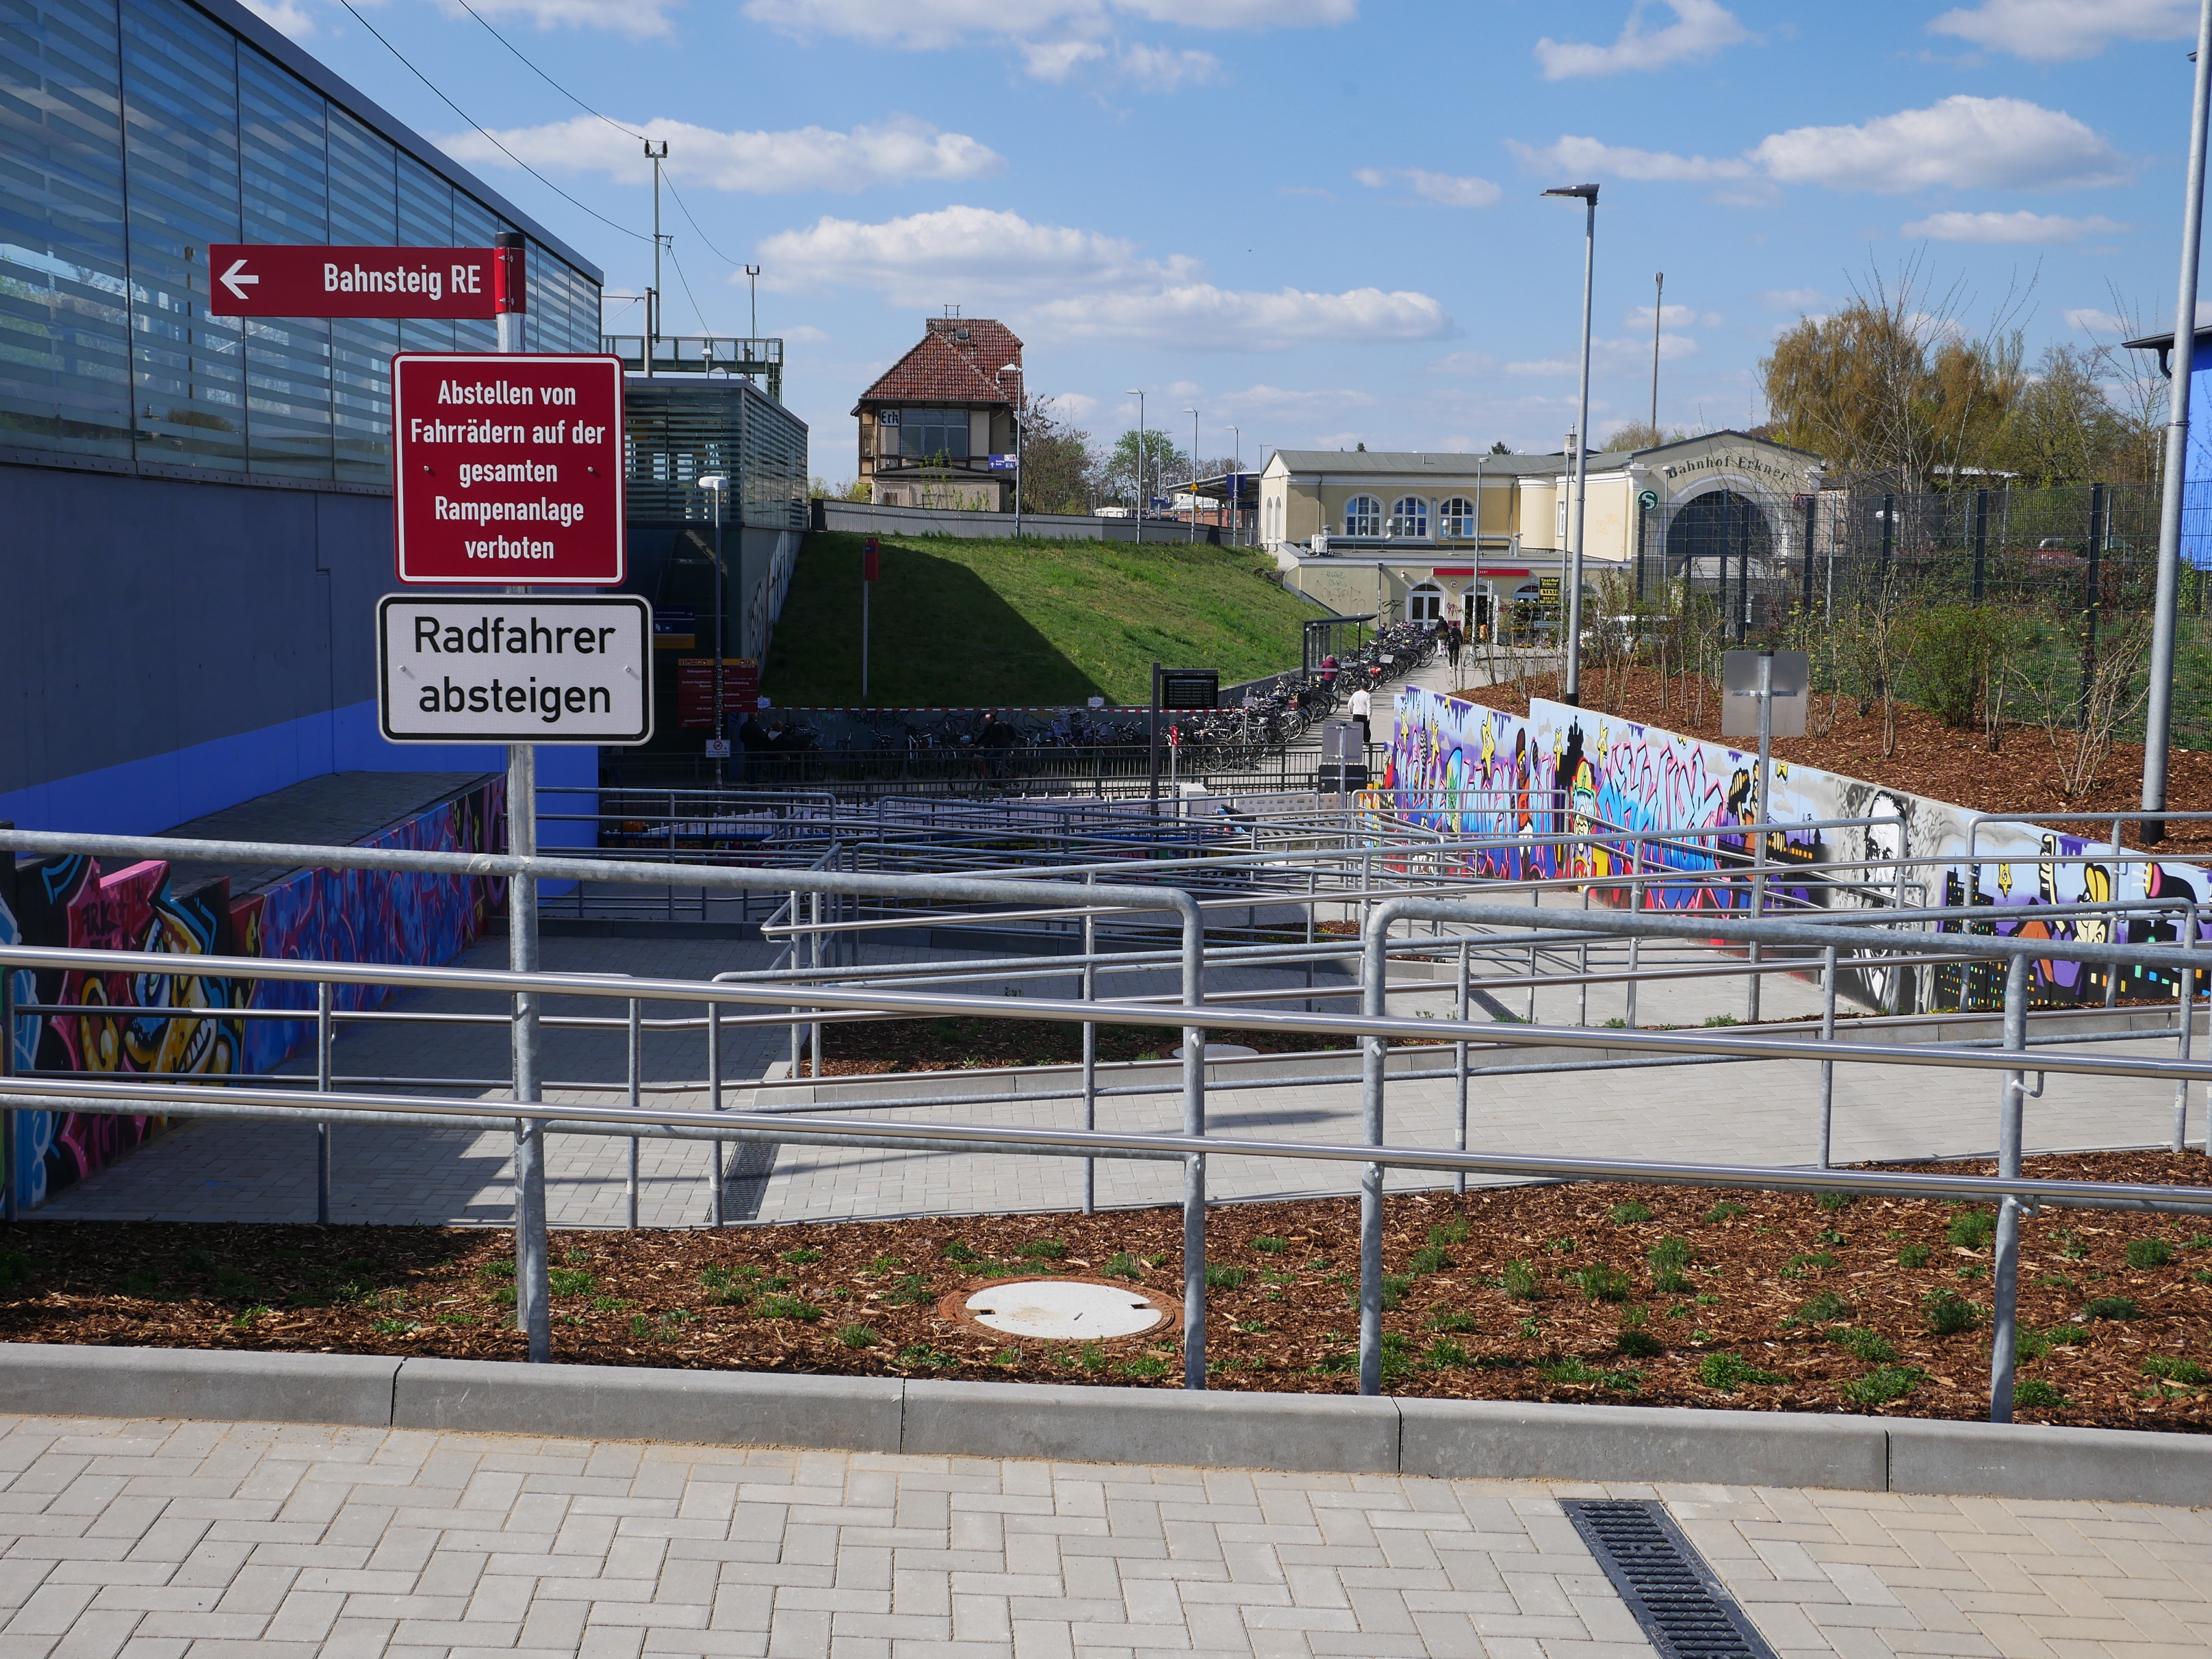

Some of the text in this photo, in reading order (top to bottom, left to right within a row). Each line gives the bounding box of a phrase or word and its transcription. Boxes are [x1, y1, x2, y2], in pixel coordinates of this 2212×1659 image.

[324, 263, 481, 300] Bahnsteig RE
[438, 381, 575, 405] Abstellen von
[882, 411, 899, 424] Erk
[411, 418, 605, 444] Fahrrädern auf der
[460, 460, 557, 487] gesamten
[1667, 455, 1789, 480] Bahnhof Erkner
[435, 496, 584, 527] Rampenanlage
[465, 535, 554, 559] verboten
[415, 617, 616, 654] Radfahrer
[420, 676, 610, 723] absteigen
